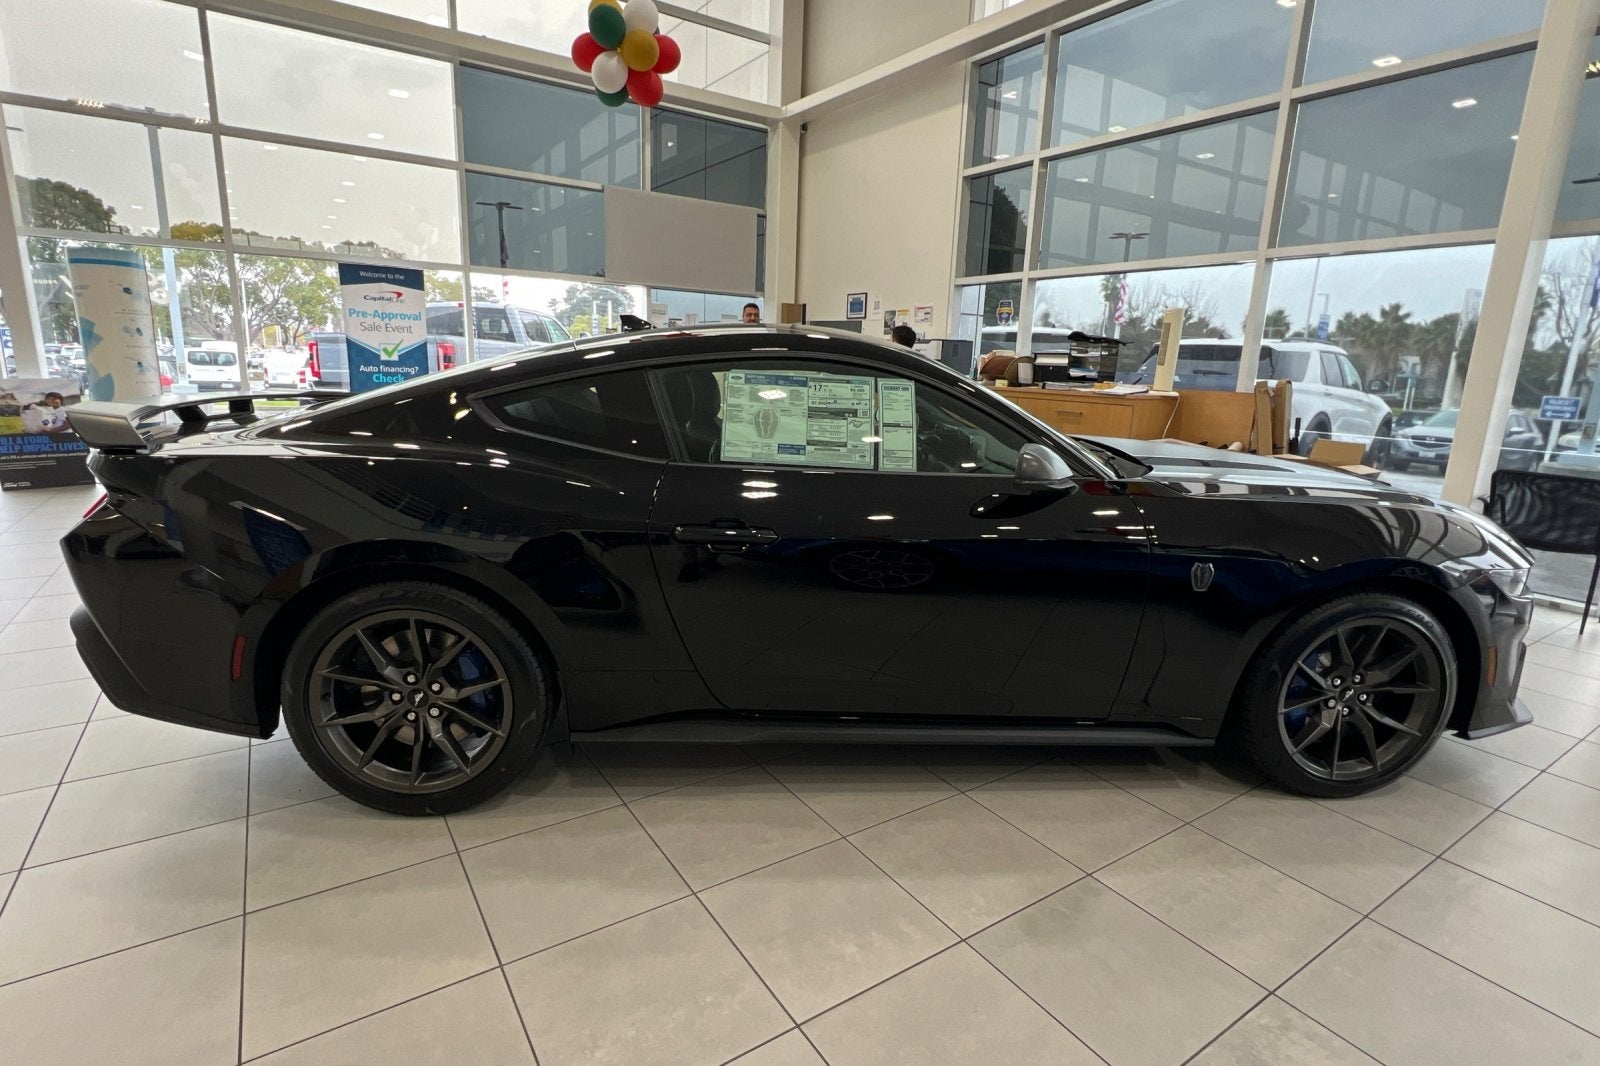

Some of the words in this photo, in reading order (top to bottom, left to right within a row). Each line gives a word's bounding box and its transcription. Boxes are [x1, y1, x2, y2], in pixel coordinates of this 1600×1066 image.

[360, 271, 386, 279] Welcome
[348, 308, 422, 321] Pre-Approval
[360, 322, 382, 332] Sale
[385, 323, 414, 334] Event
[359, 364, 379, 372] Auto
[380, 365, 419, 375] financing?
[372, 373, 405, 383] Check
